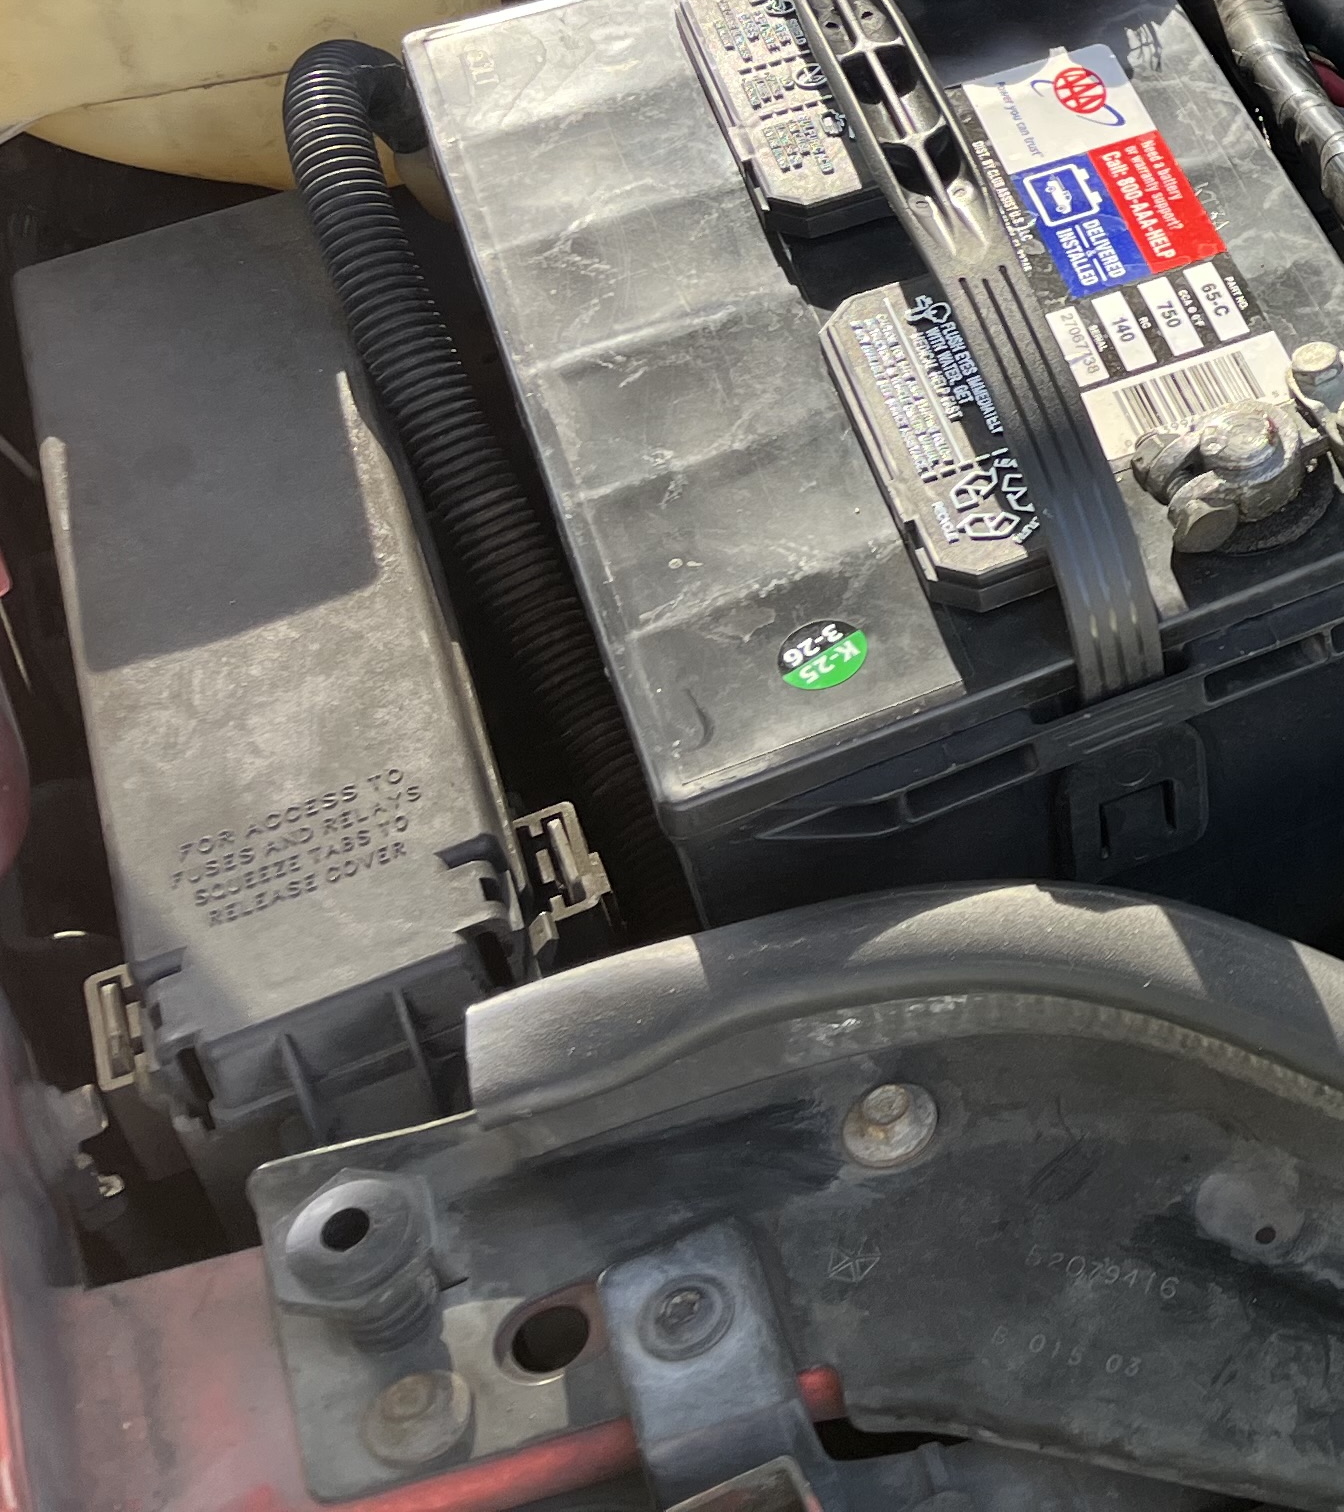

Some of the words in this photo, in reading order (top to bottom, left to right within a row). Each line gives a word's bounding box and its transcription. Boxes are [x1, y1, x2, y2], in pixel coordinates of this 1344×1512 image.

[1056, 70, 1105, 111] AAA
[1005, 104, 1022, 122] you
[1015, 122, 1030, 136] can
[1101, 149, 1130, 178] Call:
[1123, 144, 1139, 156] or
[1139, 138, 1163, 162] Need
[1155, 167, 1184, 201] battery
[1129, 154, 1161, 192] warranty
[994, 185, 1018, 213] ASSIST
[1115, 175, 1177, 259] 800-AAA-HELP
[1149, 191, 1184, 231] support?
[1056, 227, 1098, 286] INSTALLED
[1082, 219, 1126, 278] DELIVERED
[1200, 281, 1231, 318] 65-C
[1223, 276, 1242, 296] PART
[1110, 314, 1136, 343] 140
[1156, 299, 1182, 330] 750
[909, 332, 939, 370] MEDICAL
[939, 320, 967, 353] FLUSH
[924, 326, 948, 352] WITH
[951, 383, 974, 405] GET
[953, 350, 978, 376] EYES
[928, 370, 952, 397] HELP
[939, 394, 963, 421] FAST
[965, 374, 1004, 434] IMMEDIATELY
[783, 623, 844, 667] 3-26
[799, 640, 861, 684] K-25
[179, 829, 235, 863] FOR
[246, 784, 358, 838] ACCESS
[367, 768, 404, 792] TO
[172, 846, 255, 889] FUSES
[264, 826, 314, 858] AND
[323, 785, 422, 835] RELAYS
[194, 854, 302, 907] SQUEEZE
[307, 829, 371, 864] TABS
[377, 815, 409, 838] TO
[208, 872, 319, 927] RELEASE
[325, 841, 407, 884] COVER
